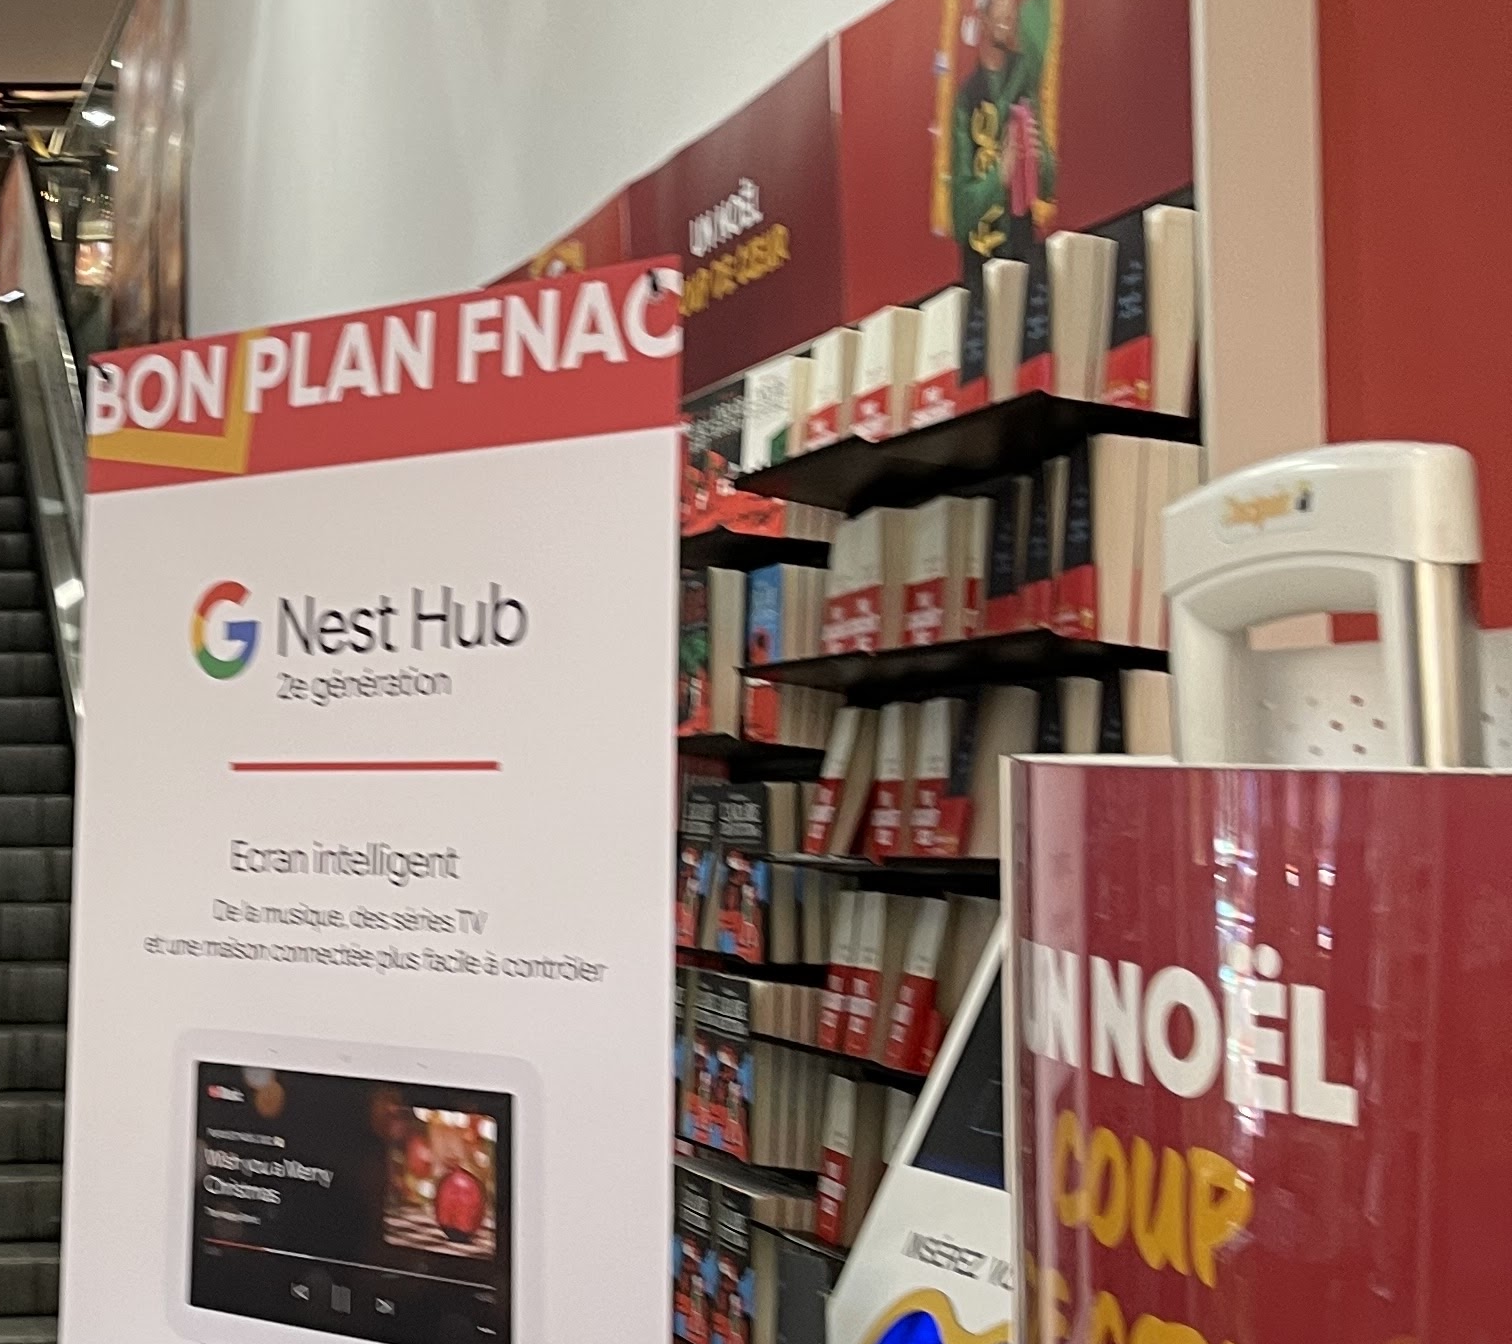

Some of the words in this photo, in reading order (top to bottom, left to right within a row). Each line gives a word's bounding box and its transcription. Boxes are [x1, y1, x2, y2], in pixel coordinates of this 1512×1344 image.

[90, 346, 226, 435] BON
[245, 310, 436, 414] PLAN
[457, 267, 684, 383] FNAC
[276, 594, 398, 657] Nest
[411, 582, 529, 652] Hub
[310, 666, 453, 707] génération
[312, 840, 462, 887] intelligent
[212, 899, 239, 922] De
[349, 905, 386, 930] des
[389, 906, 455, 934] séries
[456, 908, 488, 935] TV
[375, 945, 419, 975] plus
[422, 947, 481, 975] facile
[501, 955, 609, 983] contrôler
[1089, 943, 1359, 1126] NOËL
[1054, 1109, 1254, 1288] COUP
